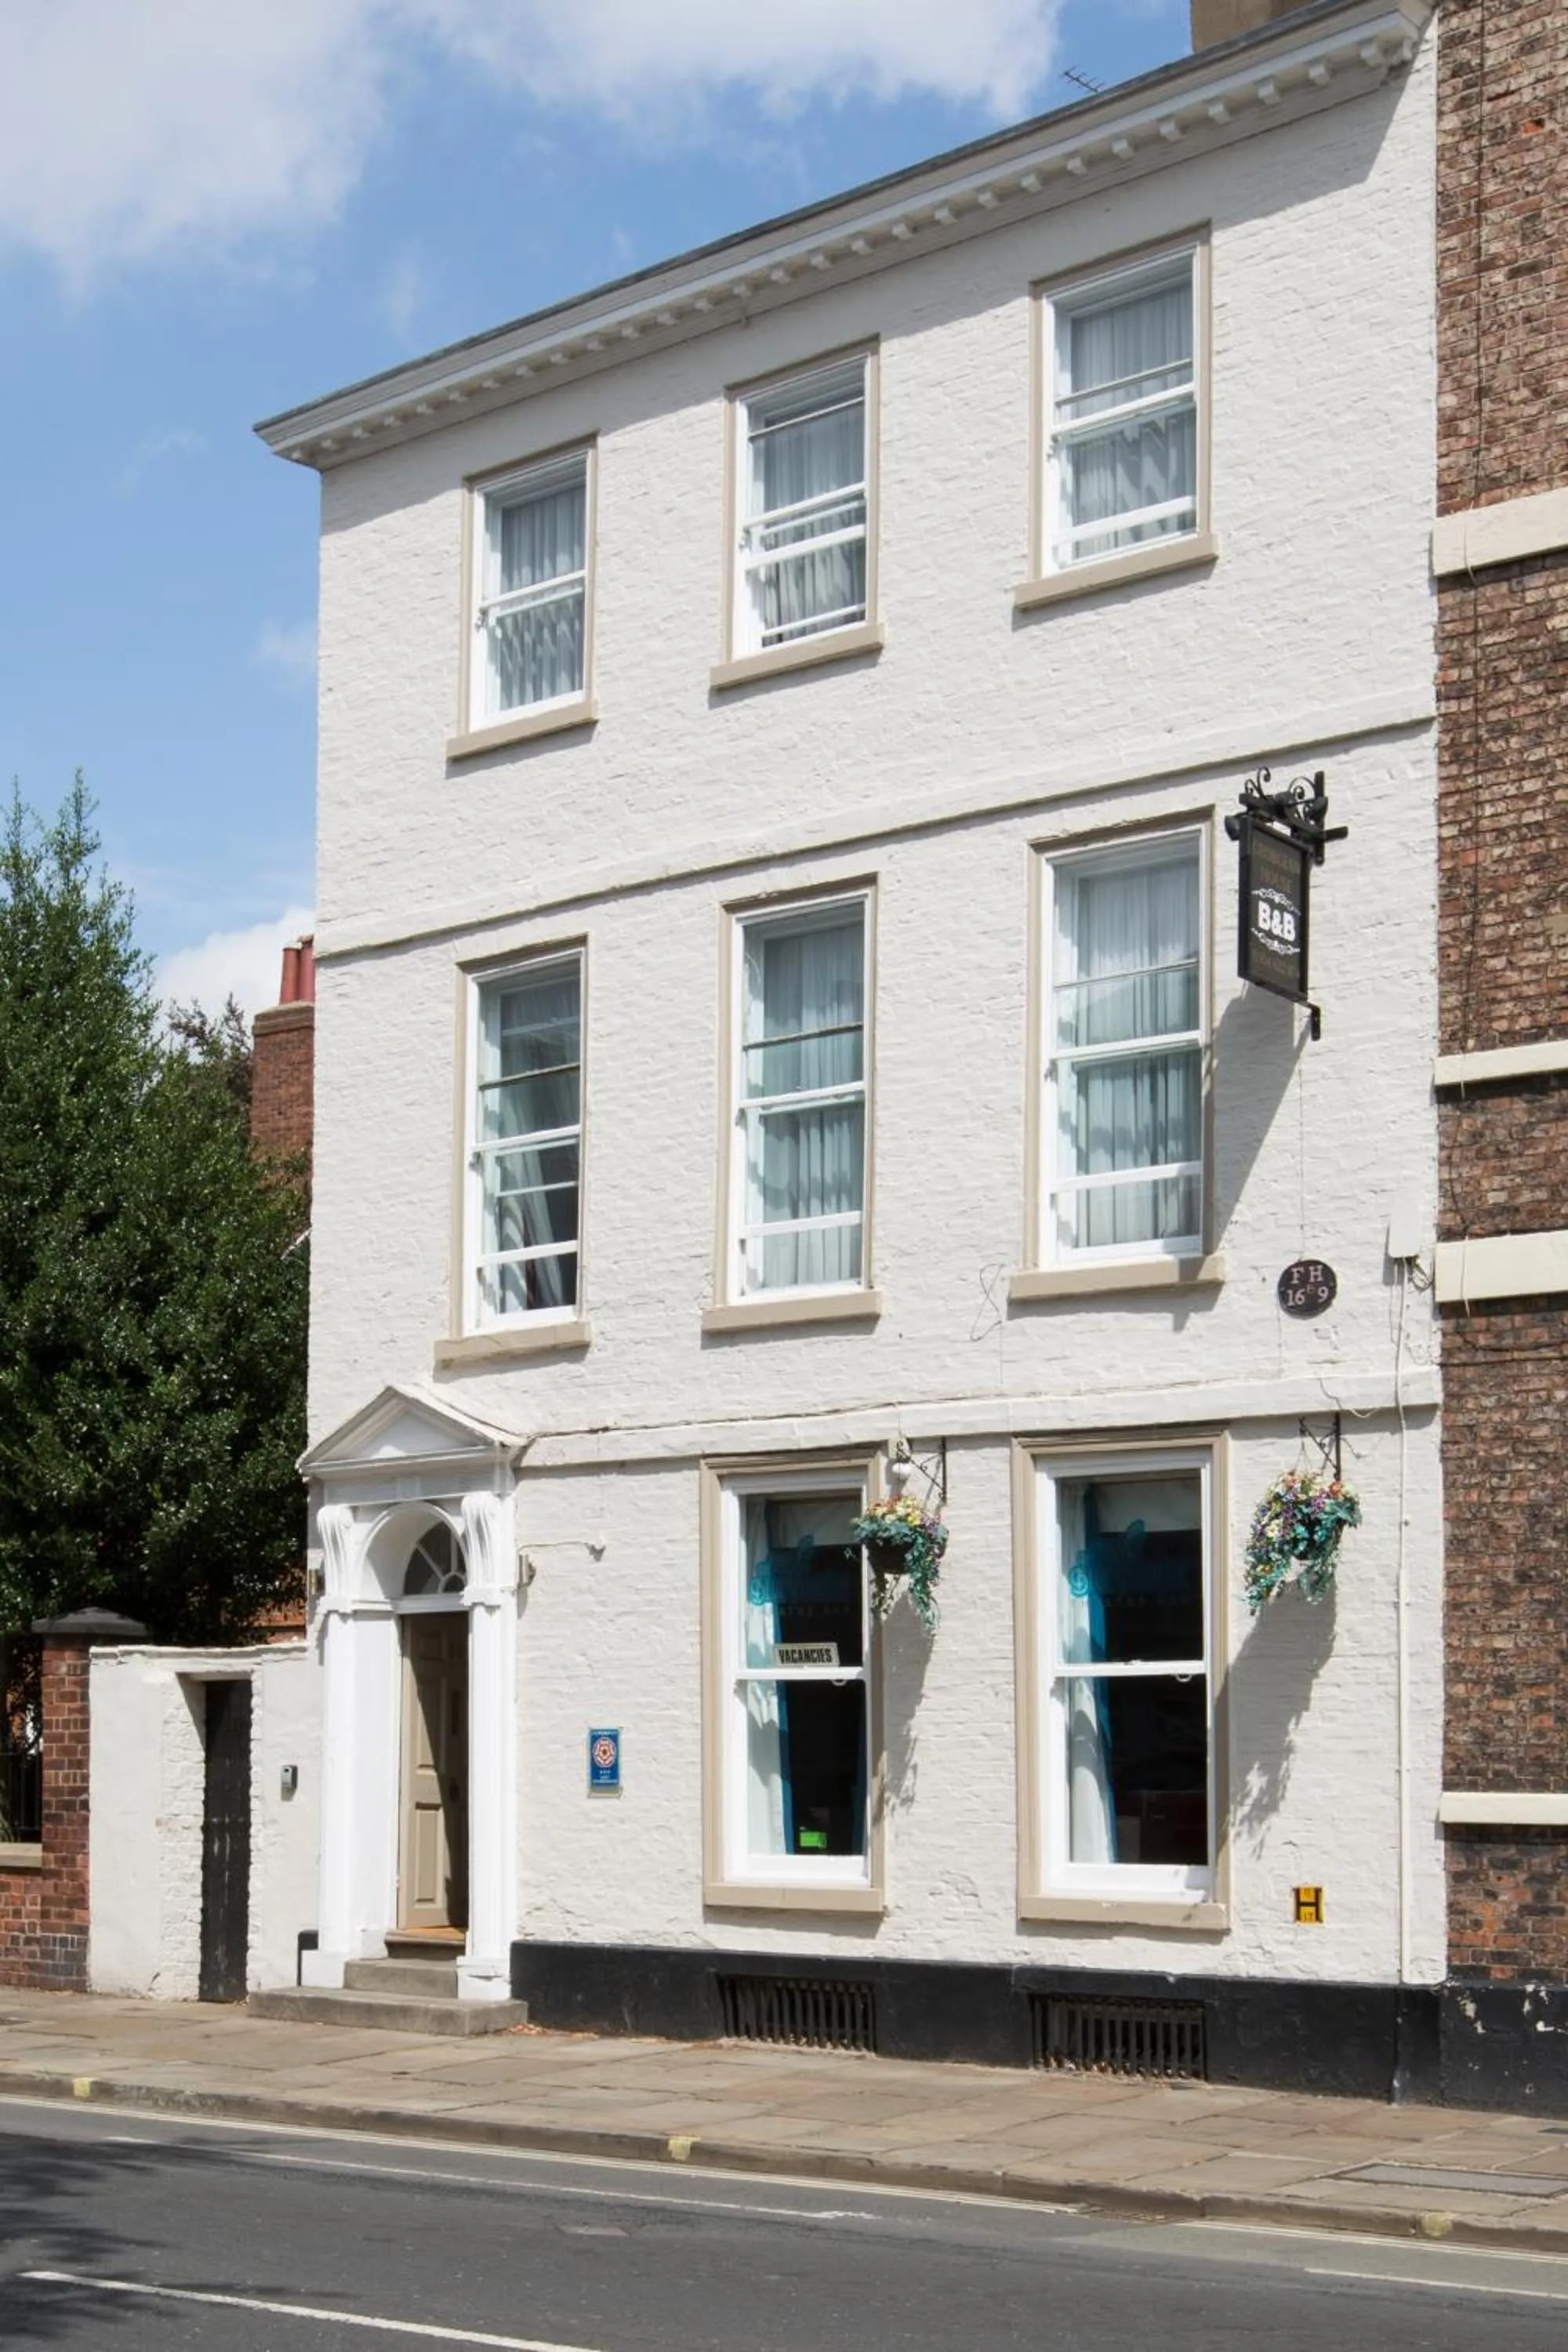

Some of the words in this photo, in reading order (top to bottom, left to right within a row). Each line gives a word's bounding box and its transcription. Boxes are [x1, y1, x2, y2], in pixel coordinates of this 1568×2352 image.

[1258, 900, 1296, 942] B&B
[1290, 1267, 1305, 1284] F
[1308, 1265, 1324, 1283] H
[1286, 1288, 1305, 1306] 16
[779, 1648, 833, 1664] VACANCIES
[1294, 1888, 1321, 1922] H
